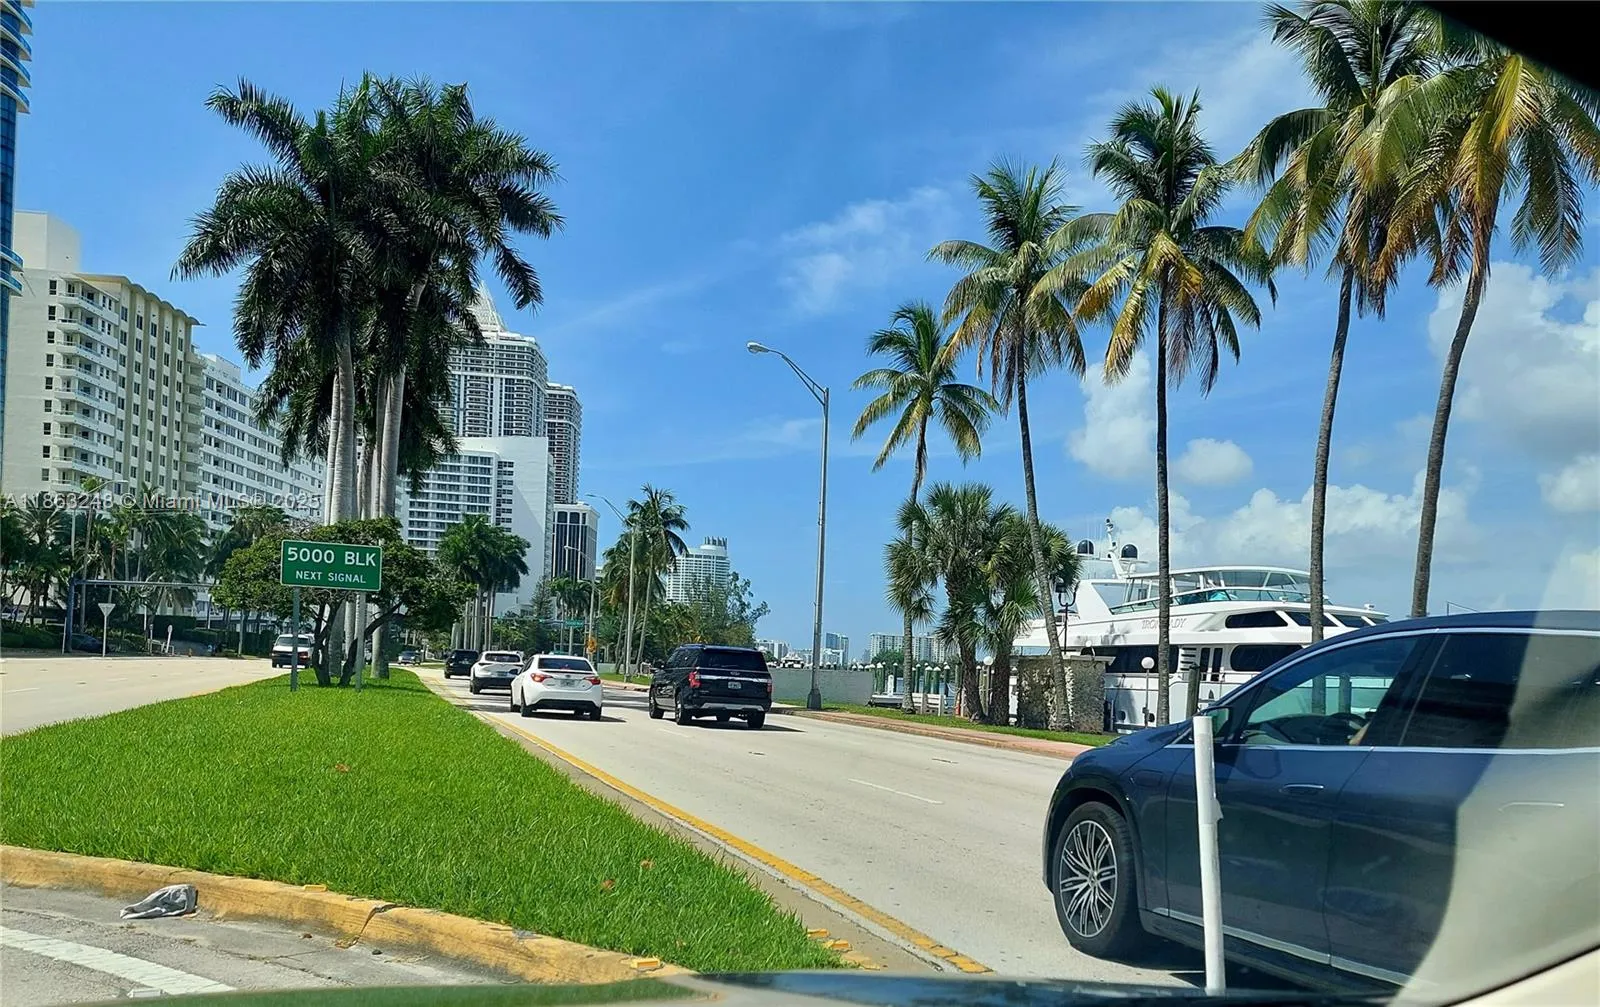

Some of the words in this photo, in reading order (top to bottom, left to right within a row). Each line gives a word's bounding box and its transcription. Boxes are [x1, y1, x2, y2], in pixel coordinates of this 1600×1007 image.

[287, 547, 335, 564] 5000
[344, 551, 376, 567] BLK
[295, 570, 322, 580] NEXT
[327, 572, 366, 584] SIGNAL
